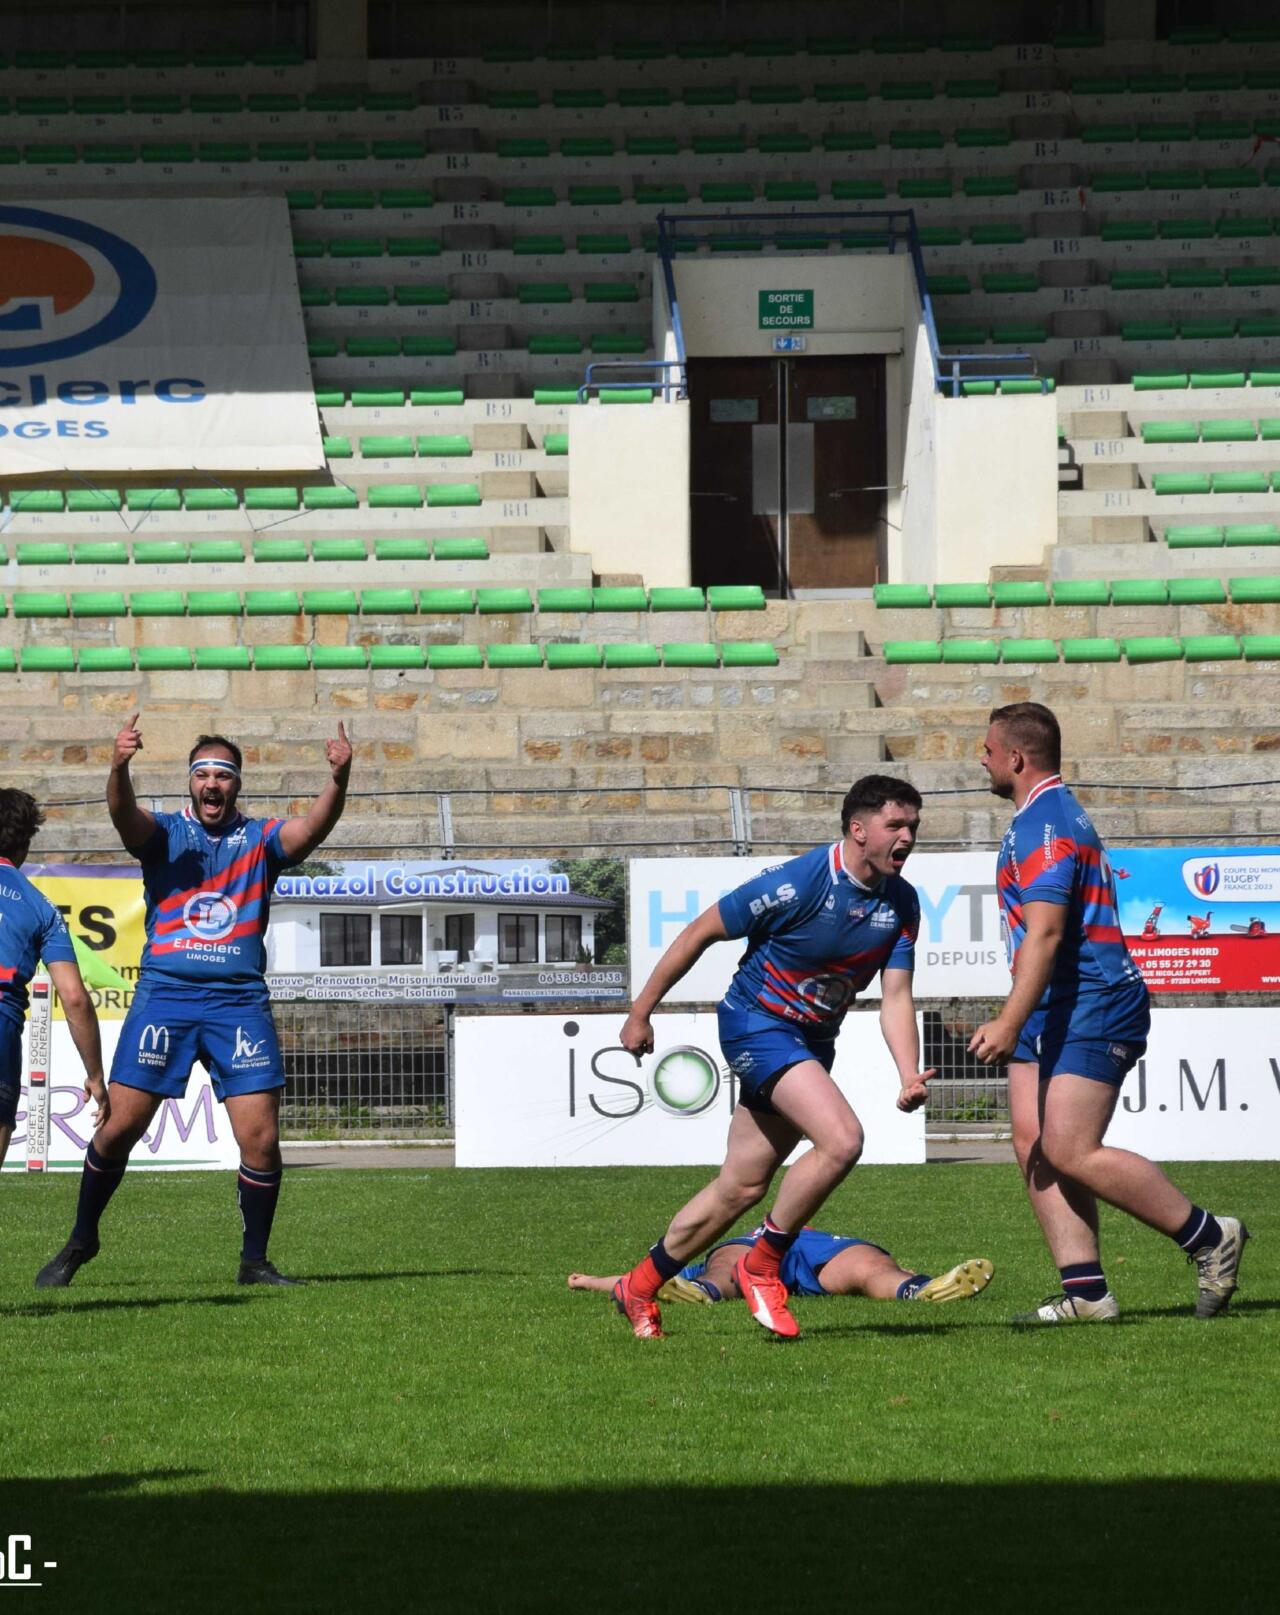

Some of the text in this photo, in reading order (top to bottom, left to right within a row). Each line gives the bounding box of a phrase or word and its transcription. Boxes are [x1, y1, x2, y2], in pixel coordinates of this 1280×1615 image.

[768, 294, 804, 303] SORTIE
[780, 305, 793, 314] DE
[762, 316, 810, 326] SECOURS
[276, 867, 568, 896] anazol Construction
[1224, 874, 1260, 884] RUGBY
[749, 884, 796, 918] BLS
[173, 938, 240, 956] E.Leclerc
[1148, 948, 1190, 956] LIMOGES
[1192, 948, 1219, 956] NORD
[186, 954, 226, 963] LIMOGES
[926, 951, 996, 966] DEPUIS
[1200, 960, 1210, 968] 30
[389, 975, 429, 985] Maison
[432, 974, 498, 985] individuelle
[540, 973, 620, 983] 06 38 54 84 38
[306, 988, 352, 998] Cloisons
[406, 988, 454, 998] Isolation
[31, 1016, 40, 1064] SOCIETE
[40, 1004, 48, 1066] GENERALE
[28, 1104, 36, 1154] SOCIETE
[37, 1094, 46, 1154] GENERALE
